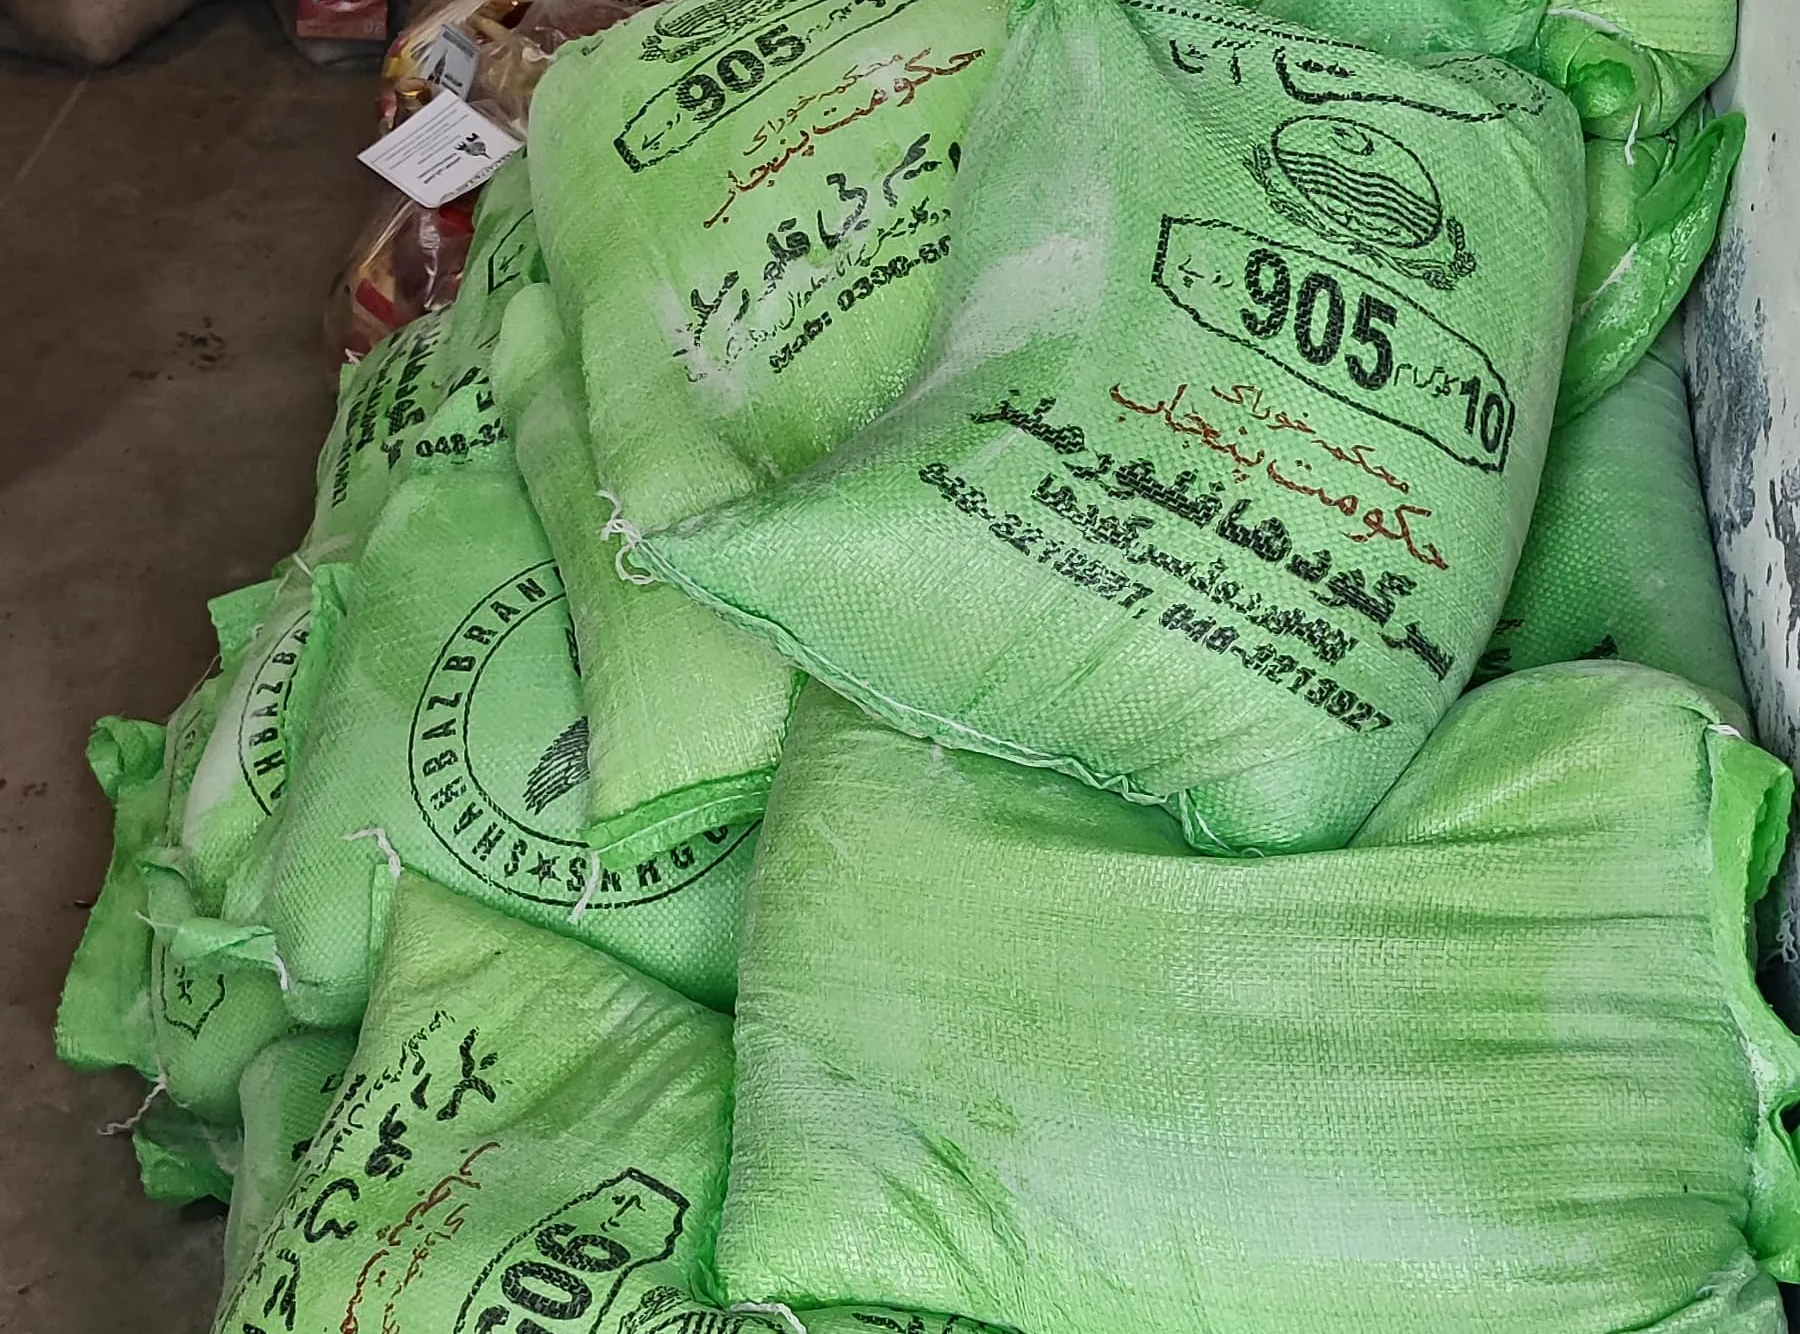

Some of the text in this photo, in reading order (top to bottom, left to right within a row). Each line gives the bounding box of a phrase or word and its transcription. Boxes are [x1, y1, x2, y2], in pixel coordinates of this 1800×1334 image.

[675, 23, 809, 123] 905
[701, 46, 986, 229] حکومت پنجاب
[1240, 246, 1397, 391] 905
[1461, 374, 1507, 452] 10
[1063, 436, 1226, 530] فلور
[1107, 381, 1450, 571] حکومت پنجاب
[1209, 383, 1410, 495] محکمہ خوراک
[1218, 502, 1455, 683] سرگودھا
[374, 1131, 501, 1247] پنجاب
